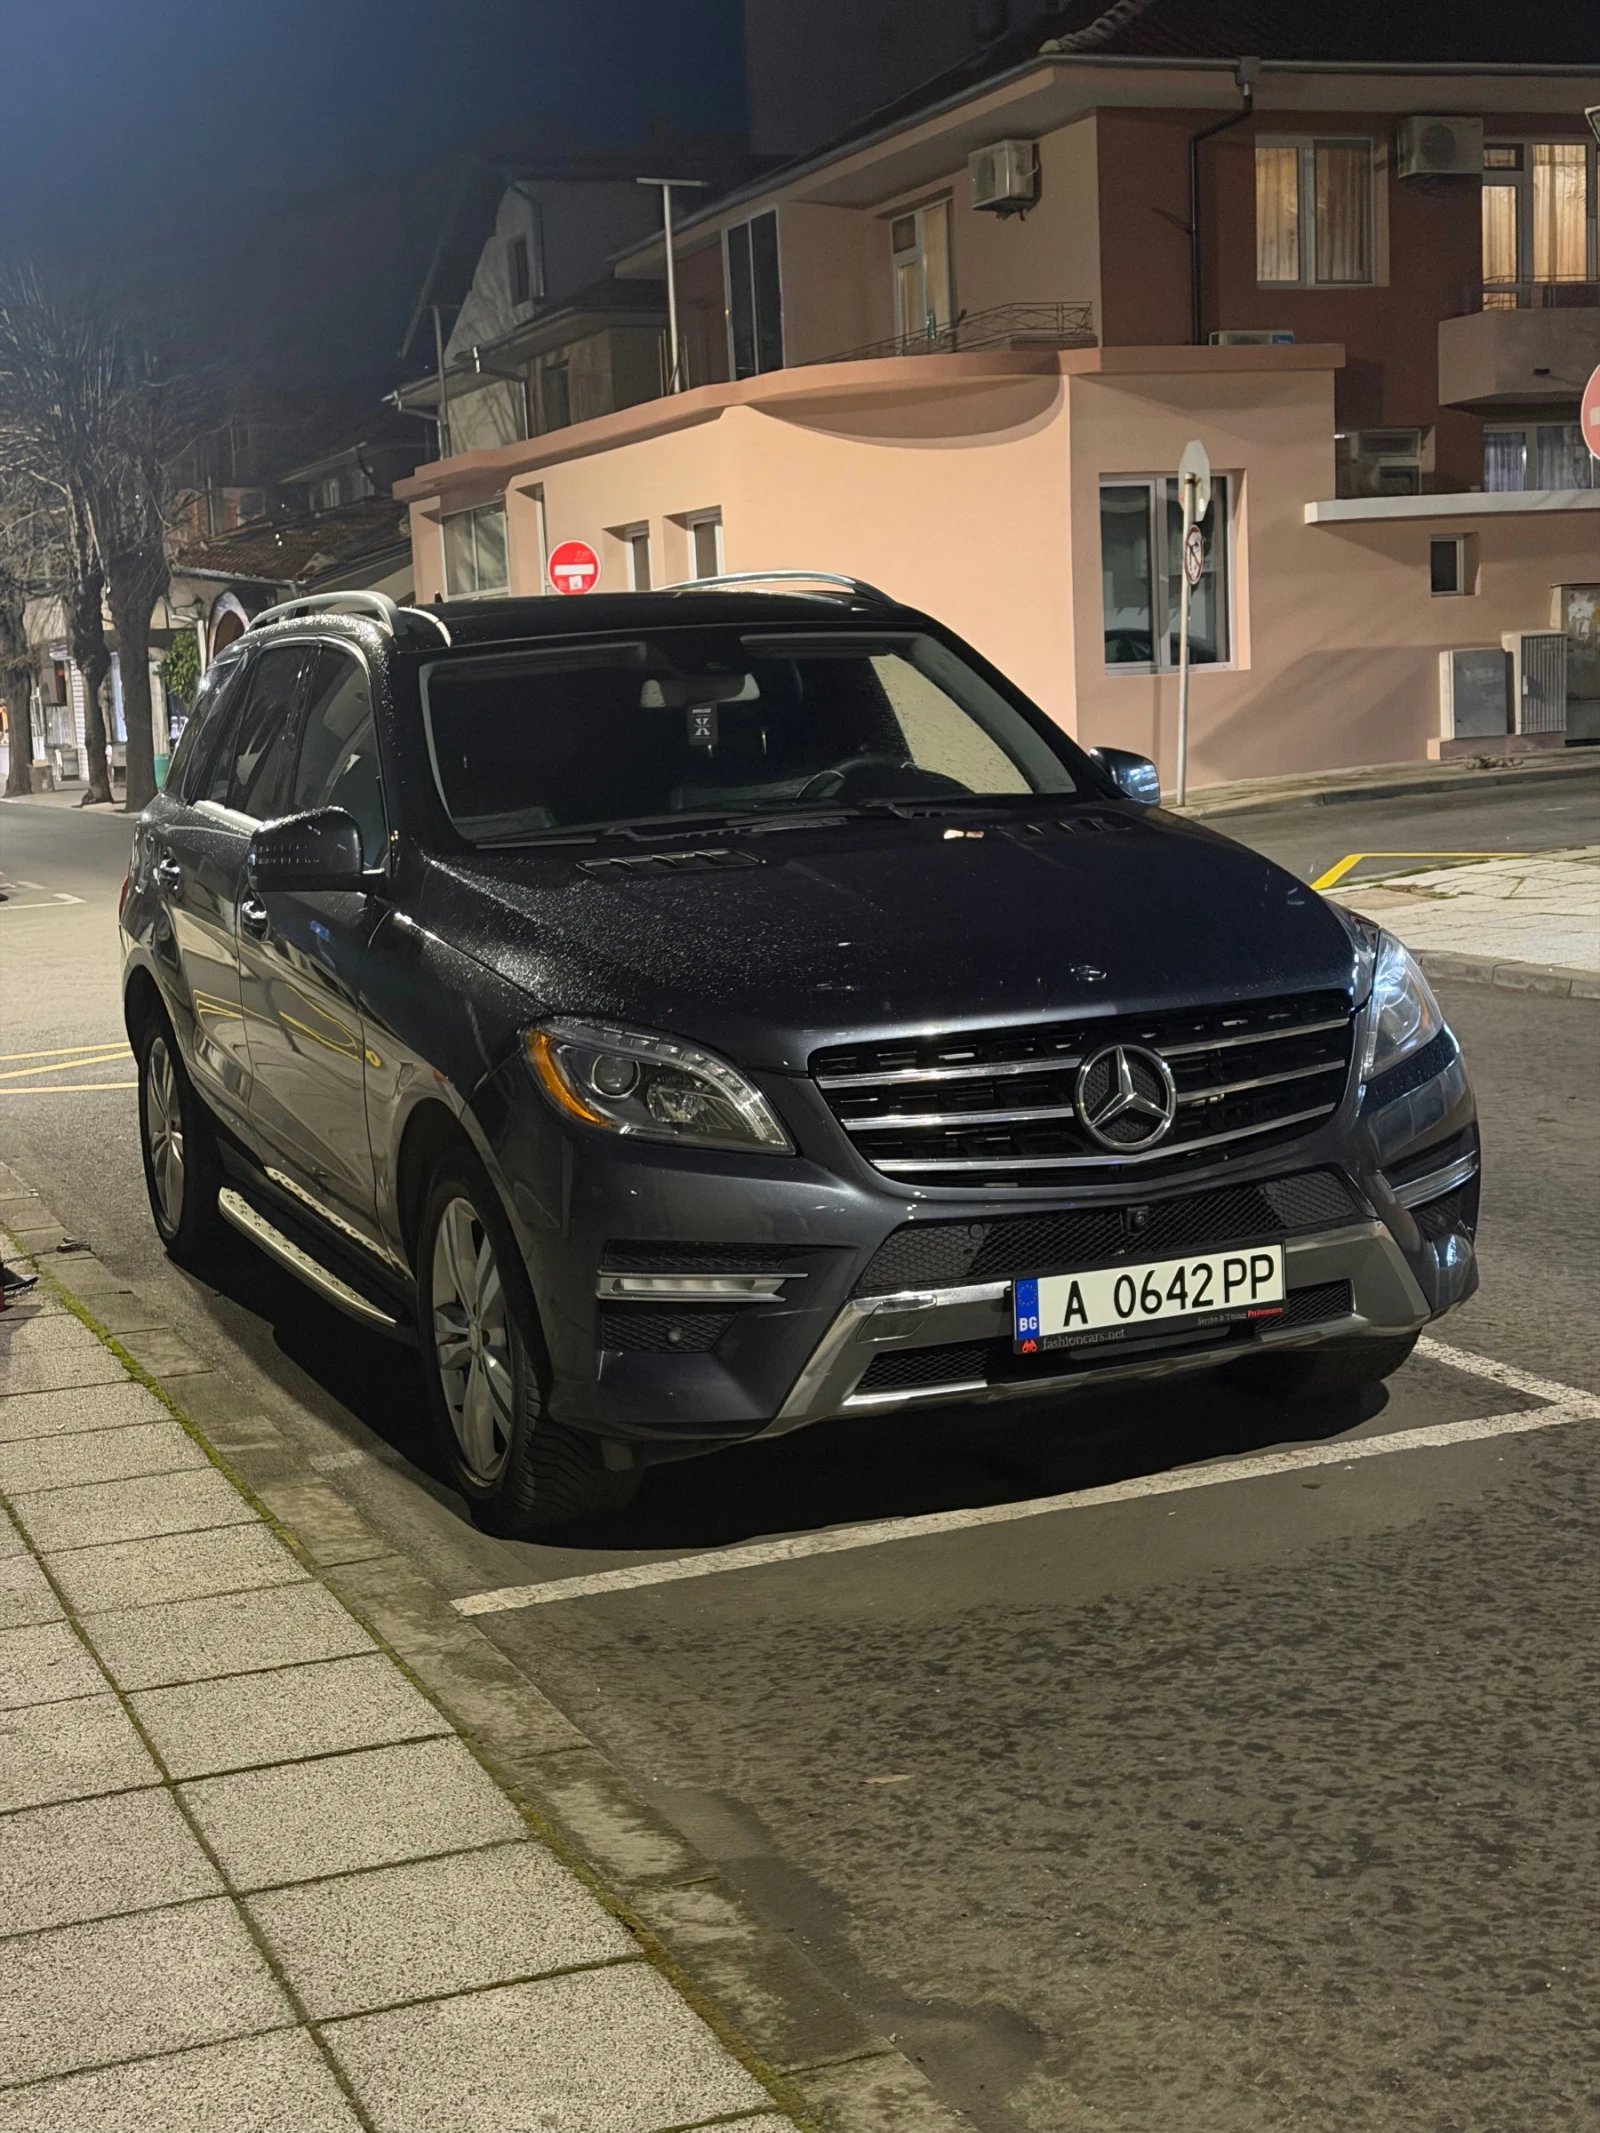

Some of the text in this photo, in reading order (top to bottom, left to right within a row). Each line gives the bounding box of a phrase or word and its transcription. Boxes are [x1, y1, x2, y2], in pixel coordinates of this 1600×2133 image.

[1063, 1280, 1089, 1327] A
[1019, 1316, 1038, 1332] BG
[1042, 1328, 1126, 1351] fashioncars.net
